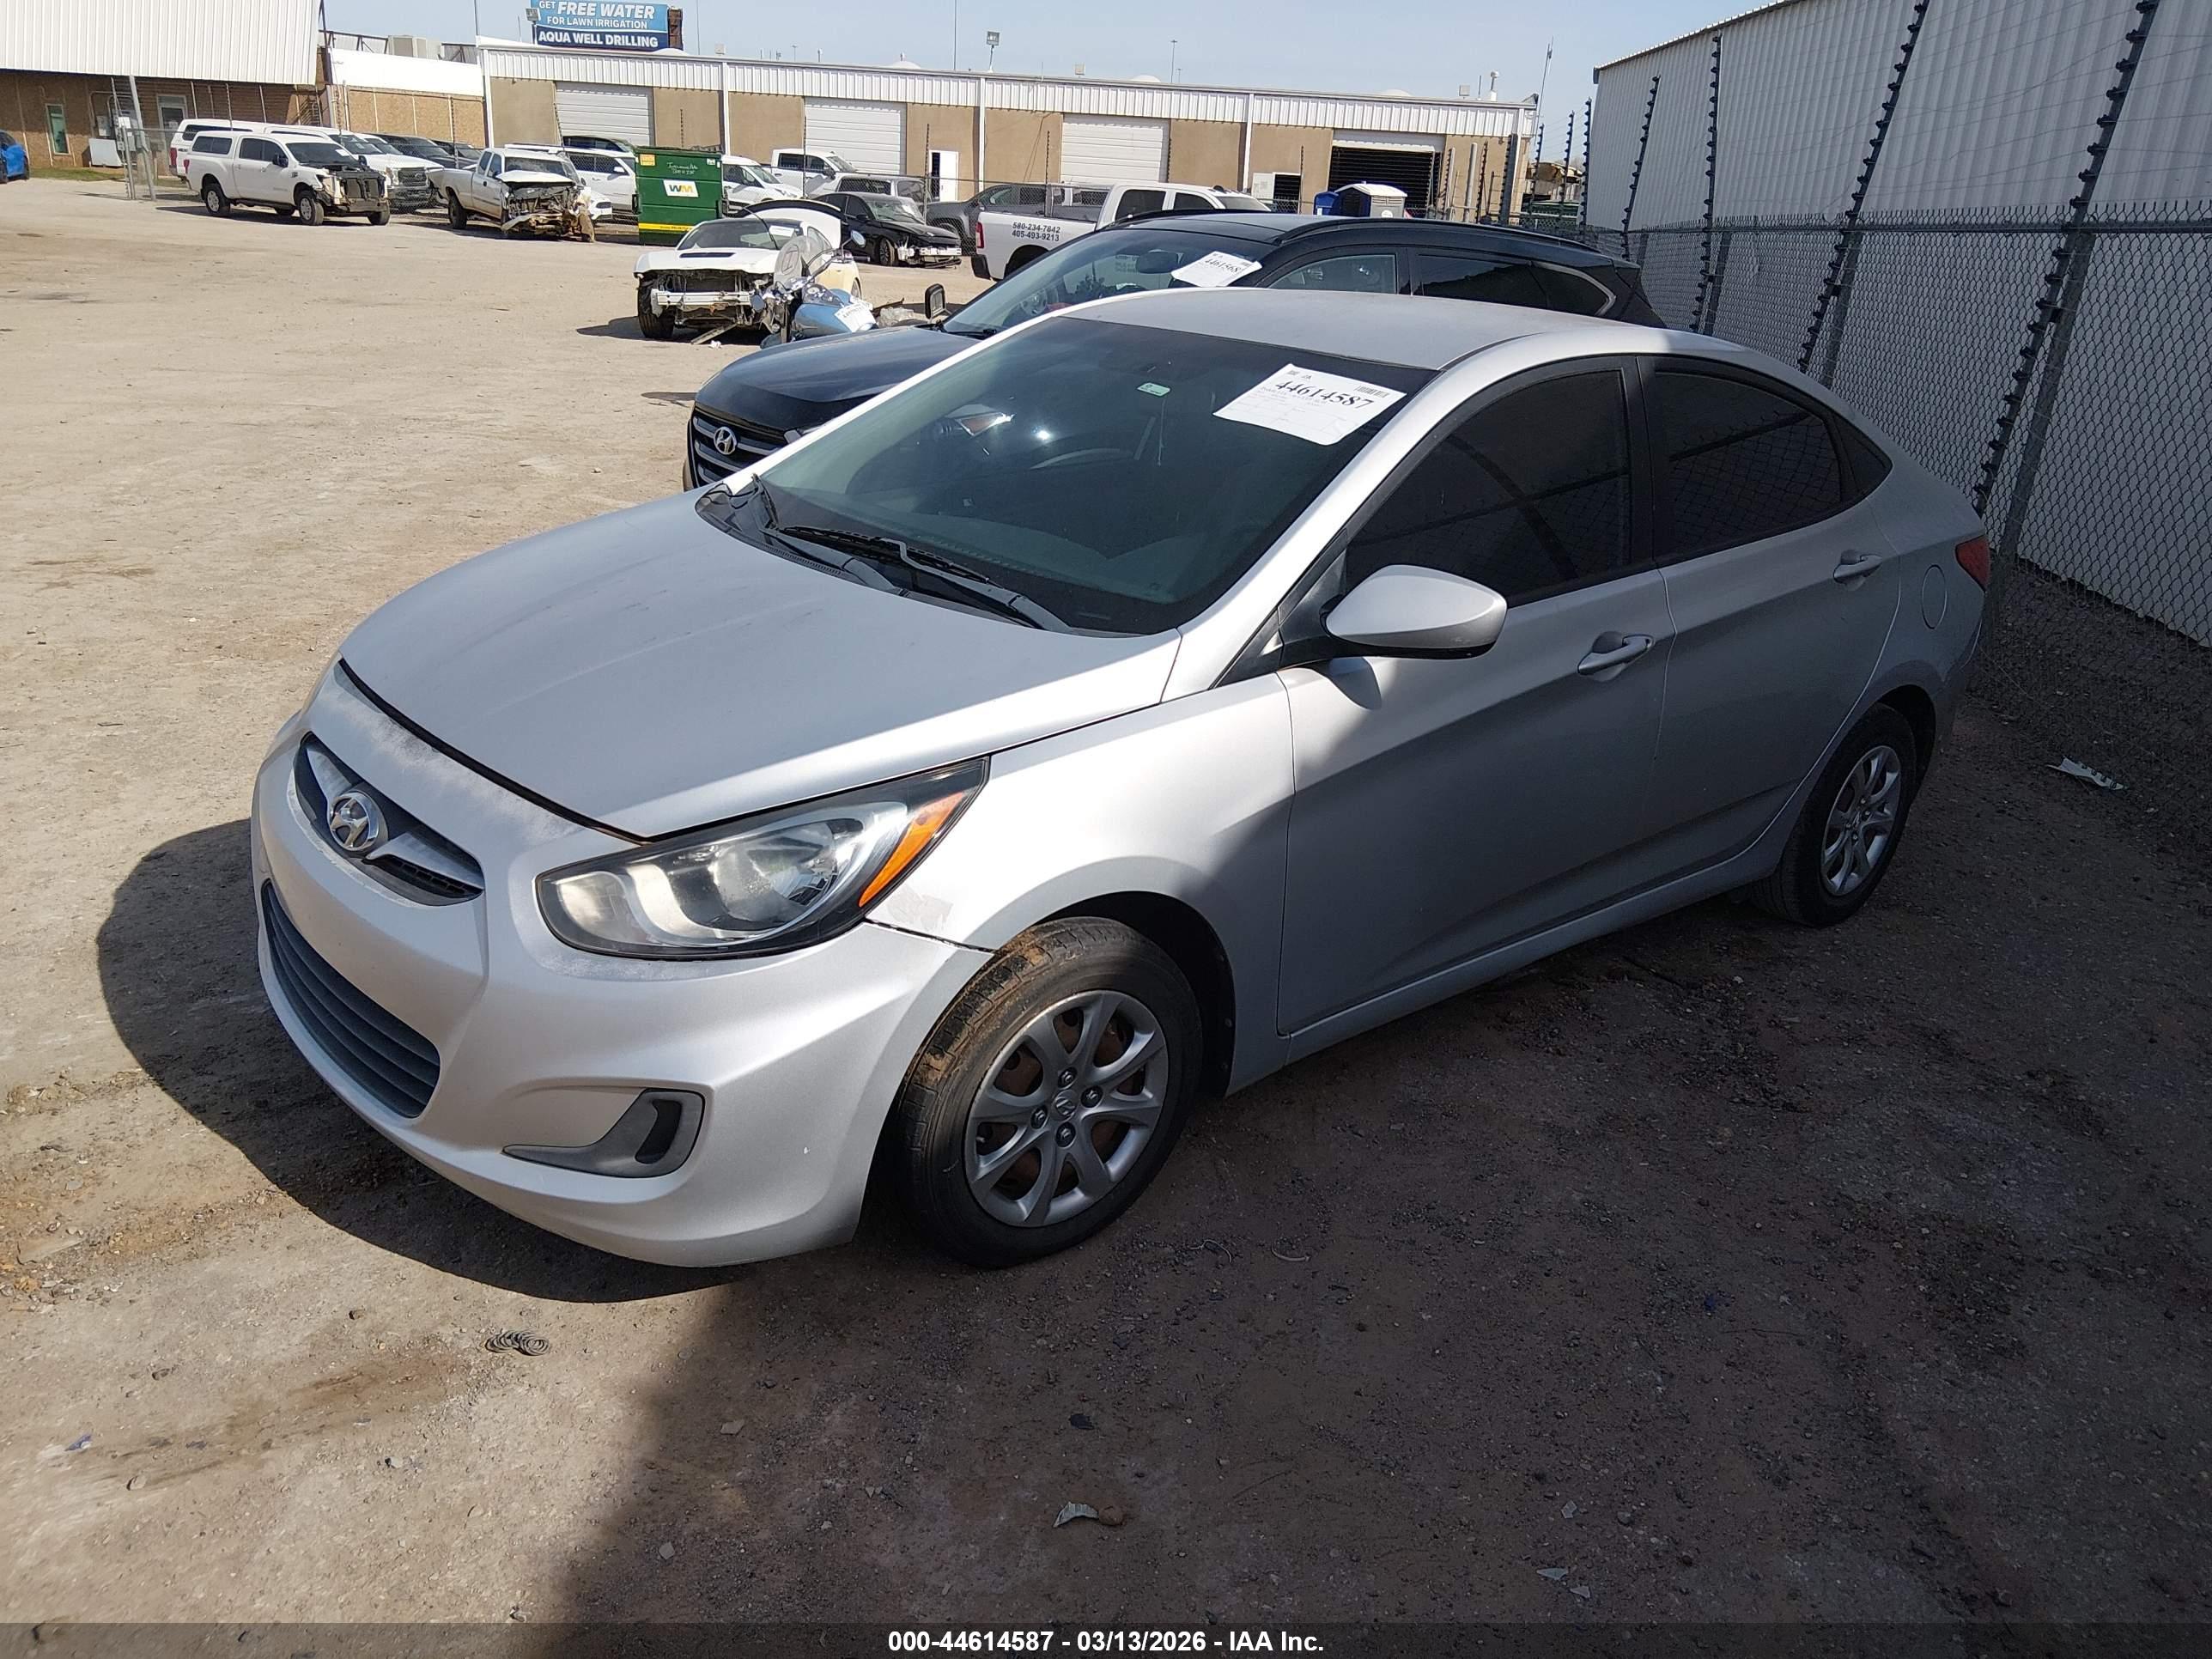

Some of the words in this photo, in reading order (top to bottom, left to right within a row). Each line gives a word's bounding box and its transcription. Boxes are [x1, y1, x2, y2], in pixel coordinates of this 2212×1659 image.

[539, 1, 556, 9] GET
[557, 1, 596, 17] FREE
[600, 3, 655, 19] WATER
[547, 16, 564, 25] FOR
[567, 17, 592, 27] LAWN
[595, 19, 647, 29] IRRIGATION
[538, 30, 572, 44] AQUA
[574, 33, 603, 46] WELL
[607, 33, 658, 48] DRILLING
[669, 184, 693, 193] WM
[1012, 222, 1060, 233] 580-234-7842
[1012, 229, 1060, 241] 405-493-9213
[1275, 380, 1375, 409] 44614587
